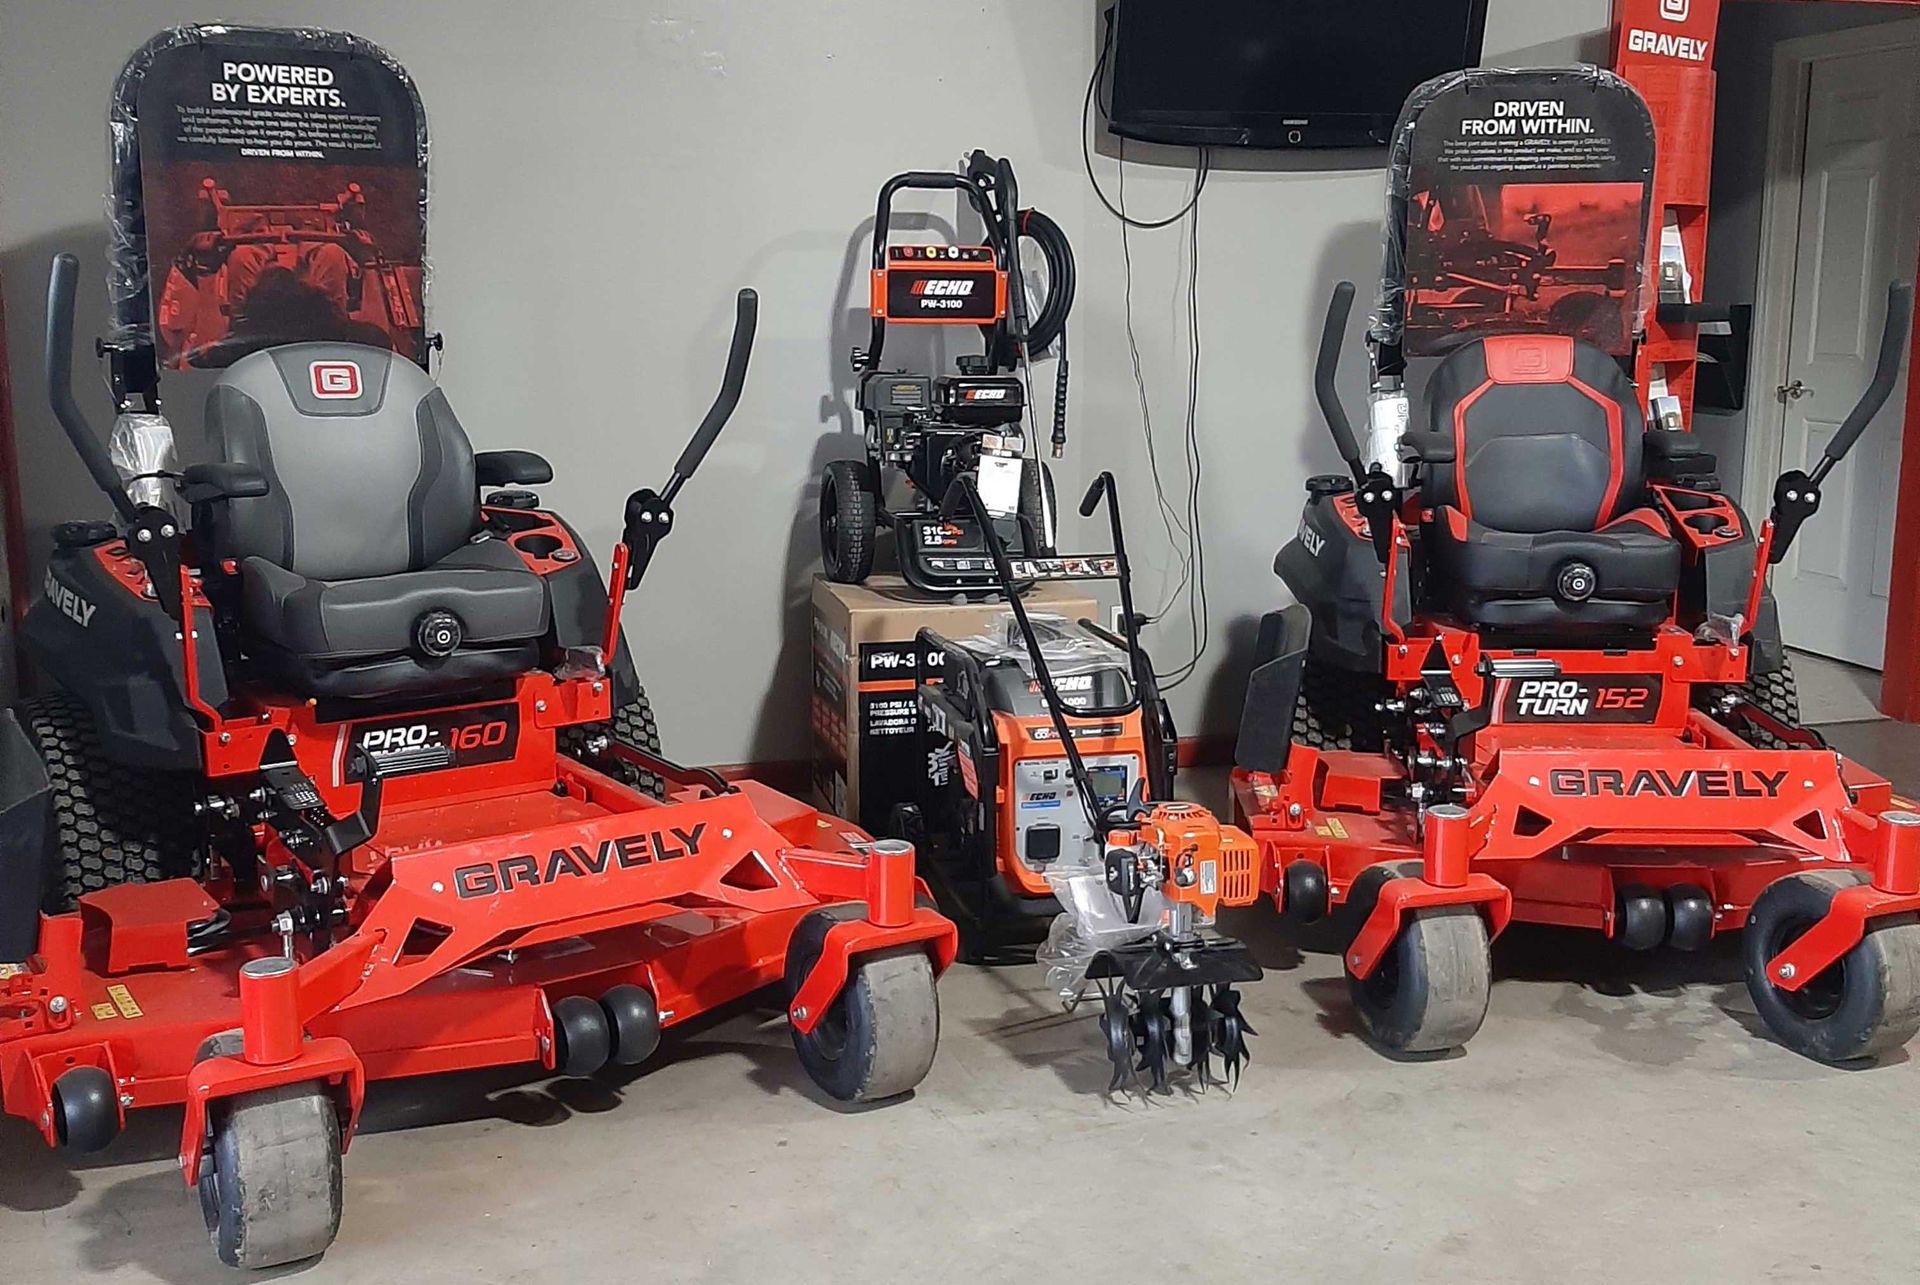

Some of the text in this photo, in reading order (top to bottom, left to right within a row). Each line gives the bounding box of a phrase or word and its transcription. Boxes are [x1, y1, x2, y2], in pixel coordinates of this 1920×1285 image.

[1628, 29, 1708, 60] GRAVELY
[223, 62, 334, 85] POWERED
[212, 83, 346, 107] BY EXPERTS.
[1494, 101, 1564, 117] DRIVEN
[1461, 118, 1595, 135] FROM WITHIN.
[271, 149, 294, 157] FROM
[924, 280, 974, 295] ECHO
[921, 299, 962, 309] PW-3100
[974, 389, 1005, 399] ECHO
[871, 652, 945, 669] PW-300
[1051, 676, 1093, 691] CHO
[1519, 681, 1588, 698] PRO-
[1517, 698, 1589, 716] TURN
[1595, 688, 1649, 709] 152
[363, 725, 439, 749] PRO-
[449, 720, 507, 751] 160
[1550, 769, 1790, 797] GRAVELY
[1030, 792, 1056, 801] ECHO
[454, 822, 708, 899] GRAVELY
